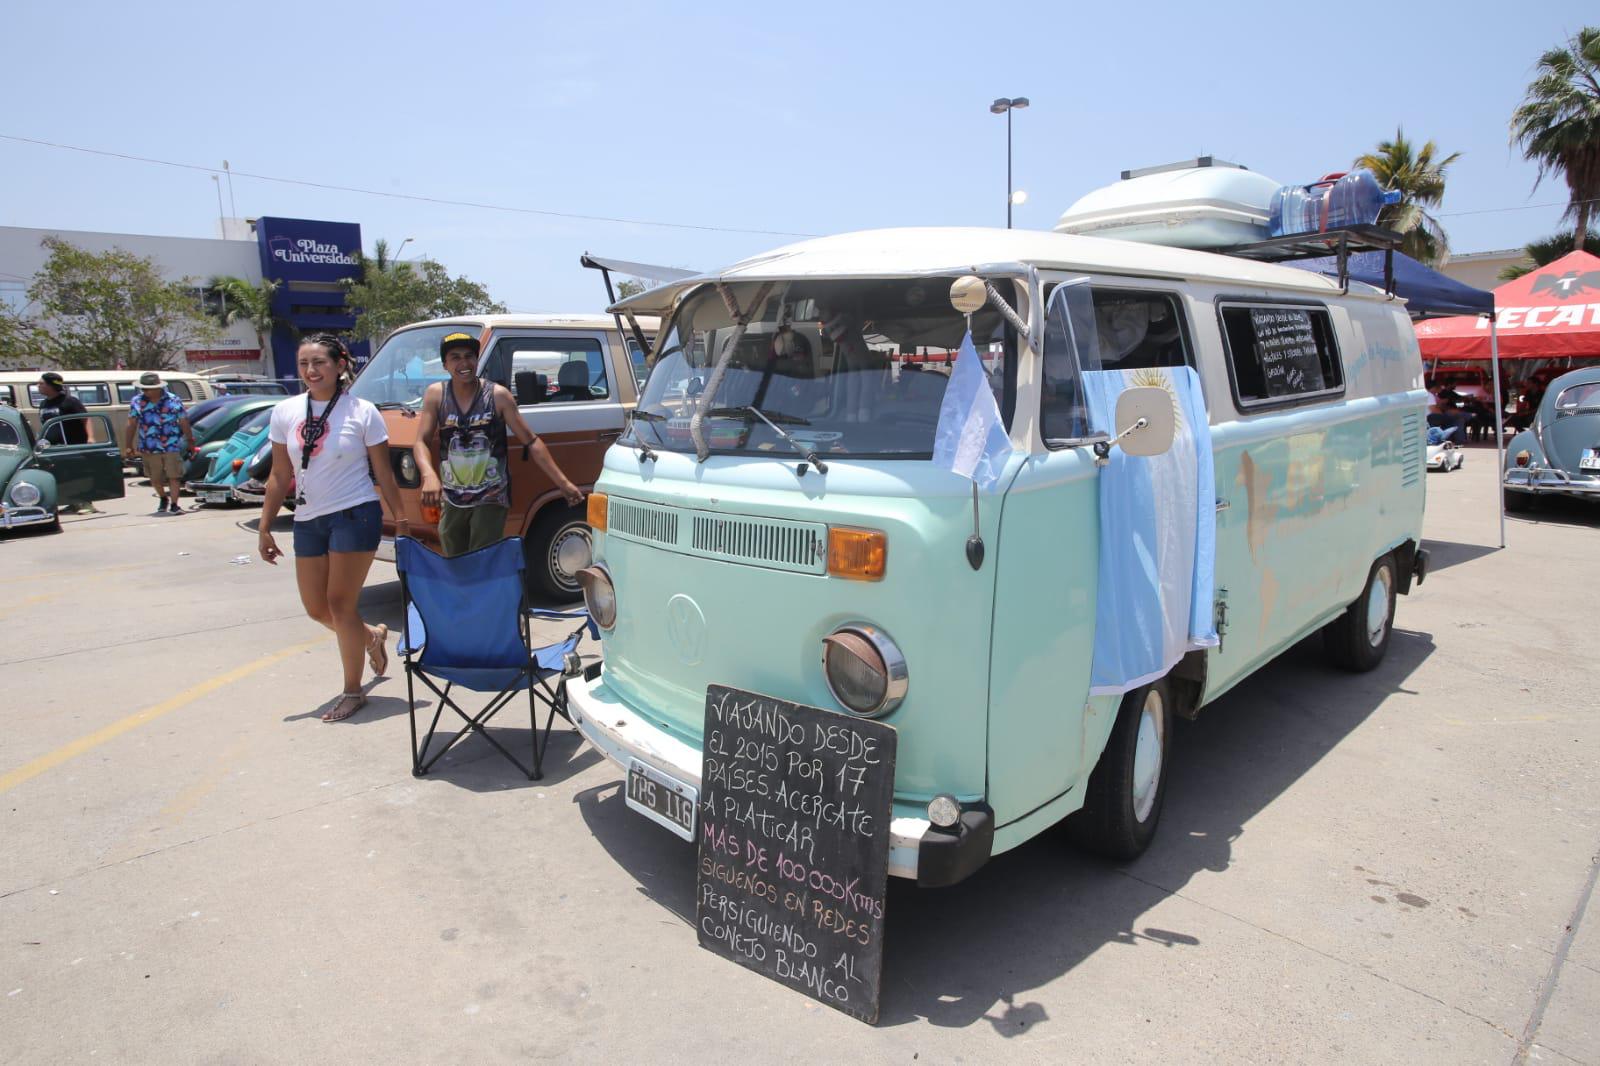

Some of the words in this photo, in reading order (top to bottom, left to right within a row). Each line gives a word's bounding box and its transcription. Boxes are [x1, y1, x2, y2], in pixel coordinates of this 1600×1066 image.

[297, 239, 339, 254] Plaza
[712, 693, 805, 745] VIAJANDO
[813, 723, 880, 764] DESDE
[709, 730, 729, 756] EL
[734, 736, 779, 771] 2015
[786, 751, 824, 793] POR
[836, 762, 868, 796] 17
[665, 790, 692, 828] 116
[703, 791, 716, 816] A
[746, 839, 768, 872] DE
[784, 892, 807, 917] EN
[812, 900, 870, 945] REDES
[702, 916, 766, 961] CONEJO
[775, 949, 849, 1001] BLANCO
[834, 952, 862, 984] AL
